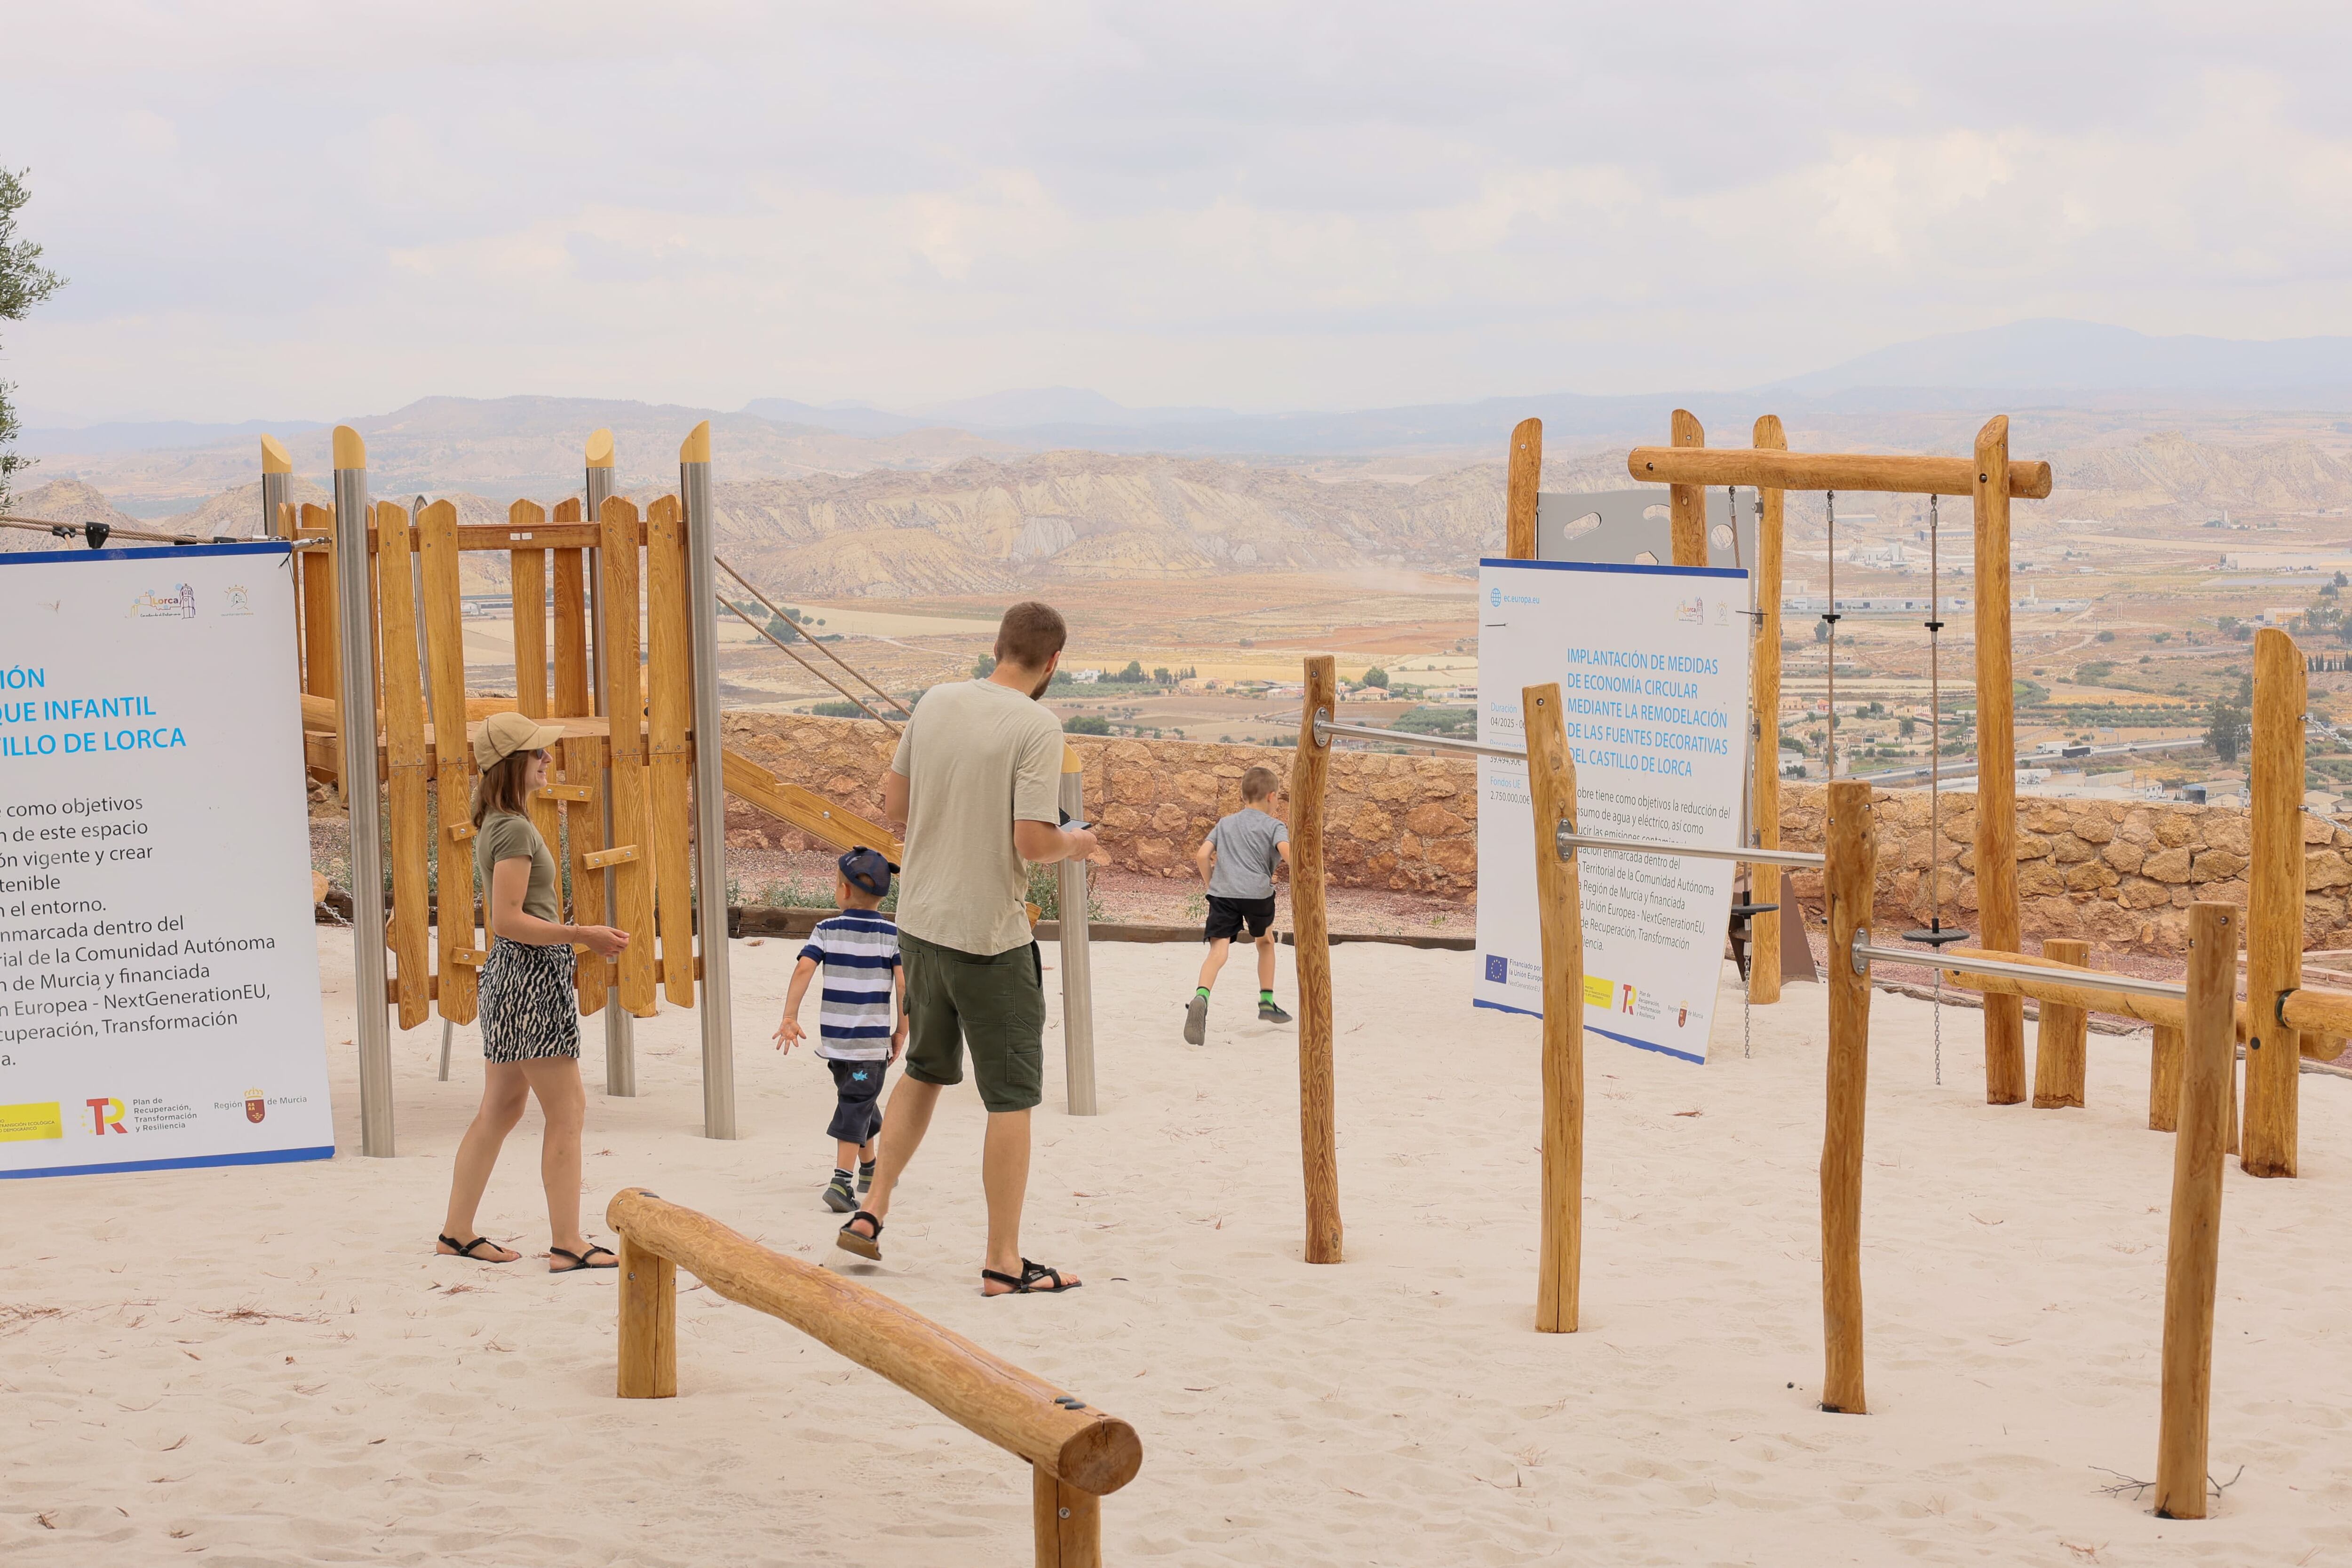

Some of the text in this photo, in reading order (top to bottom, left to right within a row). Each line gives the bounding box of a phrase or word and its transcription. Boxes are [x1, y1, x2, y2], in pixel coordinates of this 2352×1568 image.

[1503, 596, 1540, 605] ec.europa.eu
[1567, 648, 1718, 675] IMPLANTACIÓN DE MEDIDAS
[1568, 673, 1698, 700] DE ECONOMÍA CIRCULAR
[44, 696, 157, 720] INFANTIL
[1491, 702, 1517, 713] Duración
[1568, 698, 1727, 728] MEDIANTE LA REMODELACIÓN
[1491, 717, 1514, 728] 04/2025
[0, 728, 186, 756] ILLO DE LORCA
[1568, 723, 1728, 755] DE LAS FUENTES DECORATIVAS
[1569, 747, 1692, 777] DEL CASTILLO DE LORCA
[1490, 776, 1521, 788] Fondos UE
[7, 803, 56, 817] como
[62, 796, 143, 817] objetivos
[1491, 791, 1530, 804] 2.750.000,00€
[1596, 789, 1614, 802] tiene
[1615, 794, 1636, 805] como
[1637, 795, 1670, 811] objetivos
[1673, 799, 1679, 812] la
[1681, 801, 1717, 817] reducción
[1718, 806, 1730, 819] del
[13, 826, 34, 842] de
[40, 826, 76, 840] este
[81, 820, 148, 840] espacio
[1602, 808, 1611, 820] de
[1613, 813, 1630, 825] agua
[1632, 815, 1637, 827] y
[1638, 815, 1670, 831] eléctrico,
[1672, 820, 1682, 832] así
[1683, 824, 1703, 835] como
[23, 850, 90, 869] vigente
[95, 851, 104, 866] y
[110, 847, 153, 860] crear
[1603, 849, 1642, 863] enmarcada
[1644, 853, 1668, 868] dentro
[1669, 857, 1681, 870] del
[1582, 861, 1615, 877] Territorial
[1617, 868, 1626, 879] de
[1628, 869, 1633, 880] la
[1635, 870, 1676, 888] Comunidad
[1677, 878, 1714, 895] Autónoma
[1583, 880, 1607, 896] Región
[1609, 884, 1618, 897] de
[1620, 886, 1643, 902] Murcia
[1644, 895, 1648, 906] y
[1650, 891, 1685, 910] financiada
[11, 901, 25, 916] el
[31, 900, 106, 915] entorno.
[1586, 899, 1606, 913] Unión
[1608, 903, 1636, 920] Europea
[1641, 909, 1706, 935] NextGenerationEU,
[0, 915, 183, 941] nmarcada dentro del
[1590, 918, 1637, 940] Recuperación,
[1638, 928, 1690, 950] Transformación
[28, 949, 50, 965] de
[56, 948, 70, 963] la
[75, 940, 178, 962] Comunidad
[184, 937, 275, 954] Autónoma
[1510, 959, 1533, 970] Financiado
[1514, 970, 1526, 979] Unión
[13, 975, 34, 991] de
[41, 971, 100, 989] Murcia
[104, 973, 114, 988] y
[119, 963, 210, 983] financiada
[15, 1000, 87, 1017] Europea
[104, 983, 270, 1009] NextGenerationEU,
[101, 1011, 237, 1034] Transformación
[1, 1055, 16, 1066] a.
[134, 1104, 191, 1114] Recuperación,
[214, 1101, 242, 1110] Región
[280, 1096, 307, 1104] Murcia
[134, 1112, 197, 1123] Transformación
[143, 1122, 186, 1130] Resiliencia
